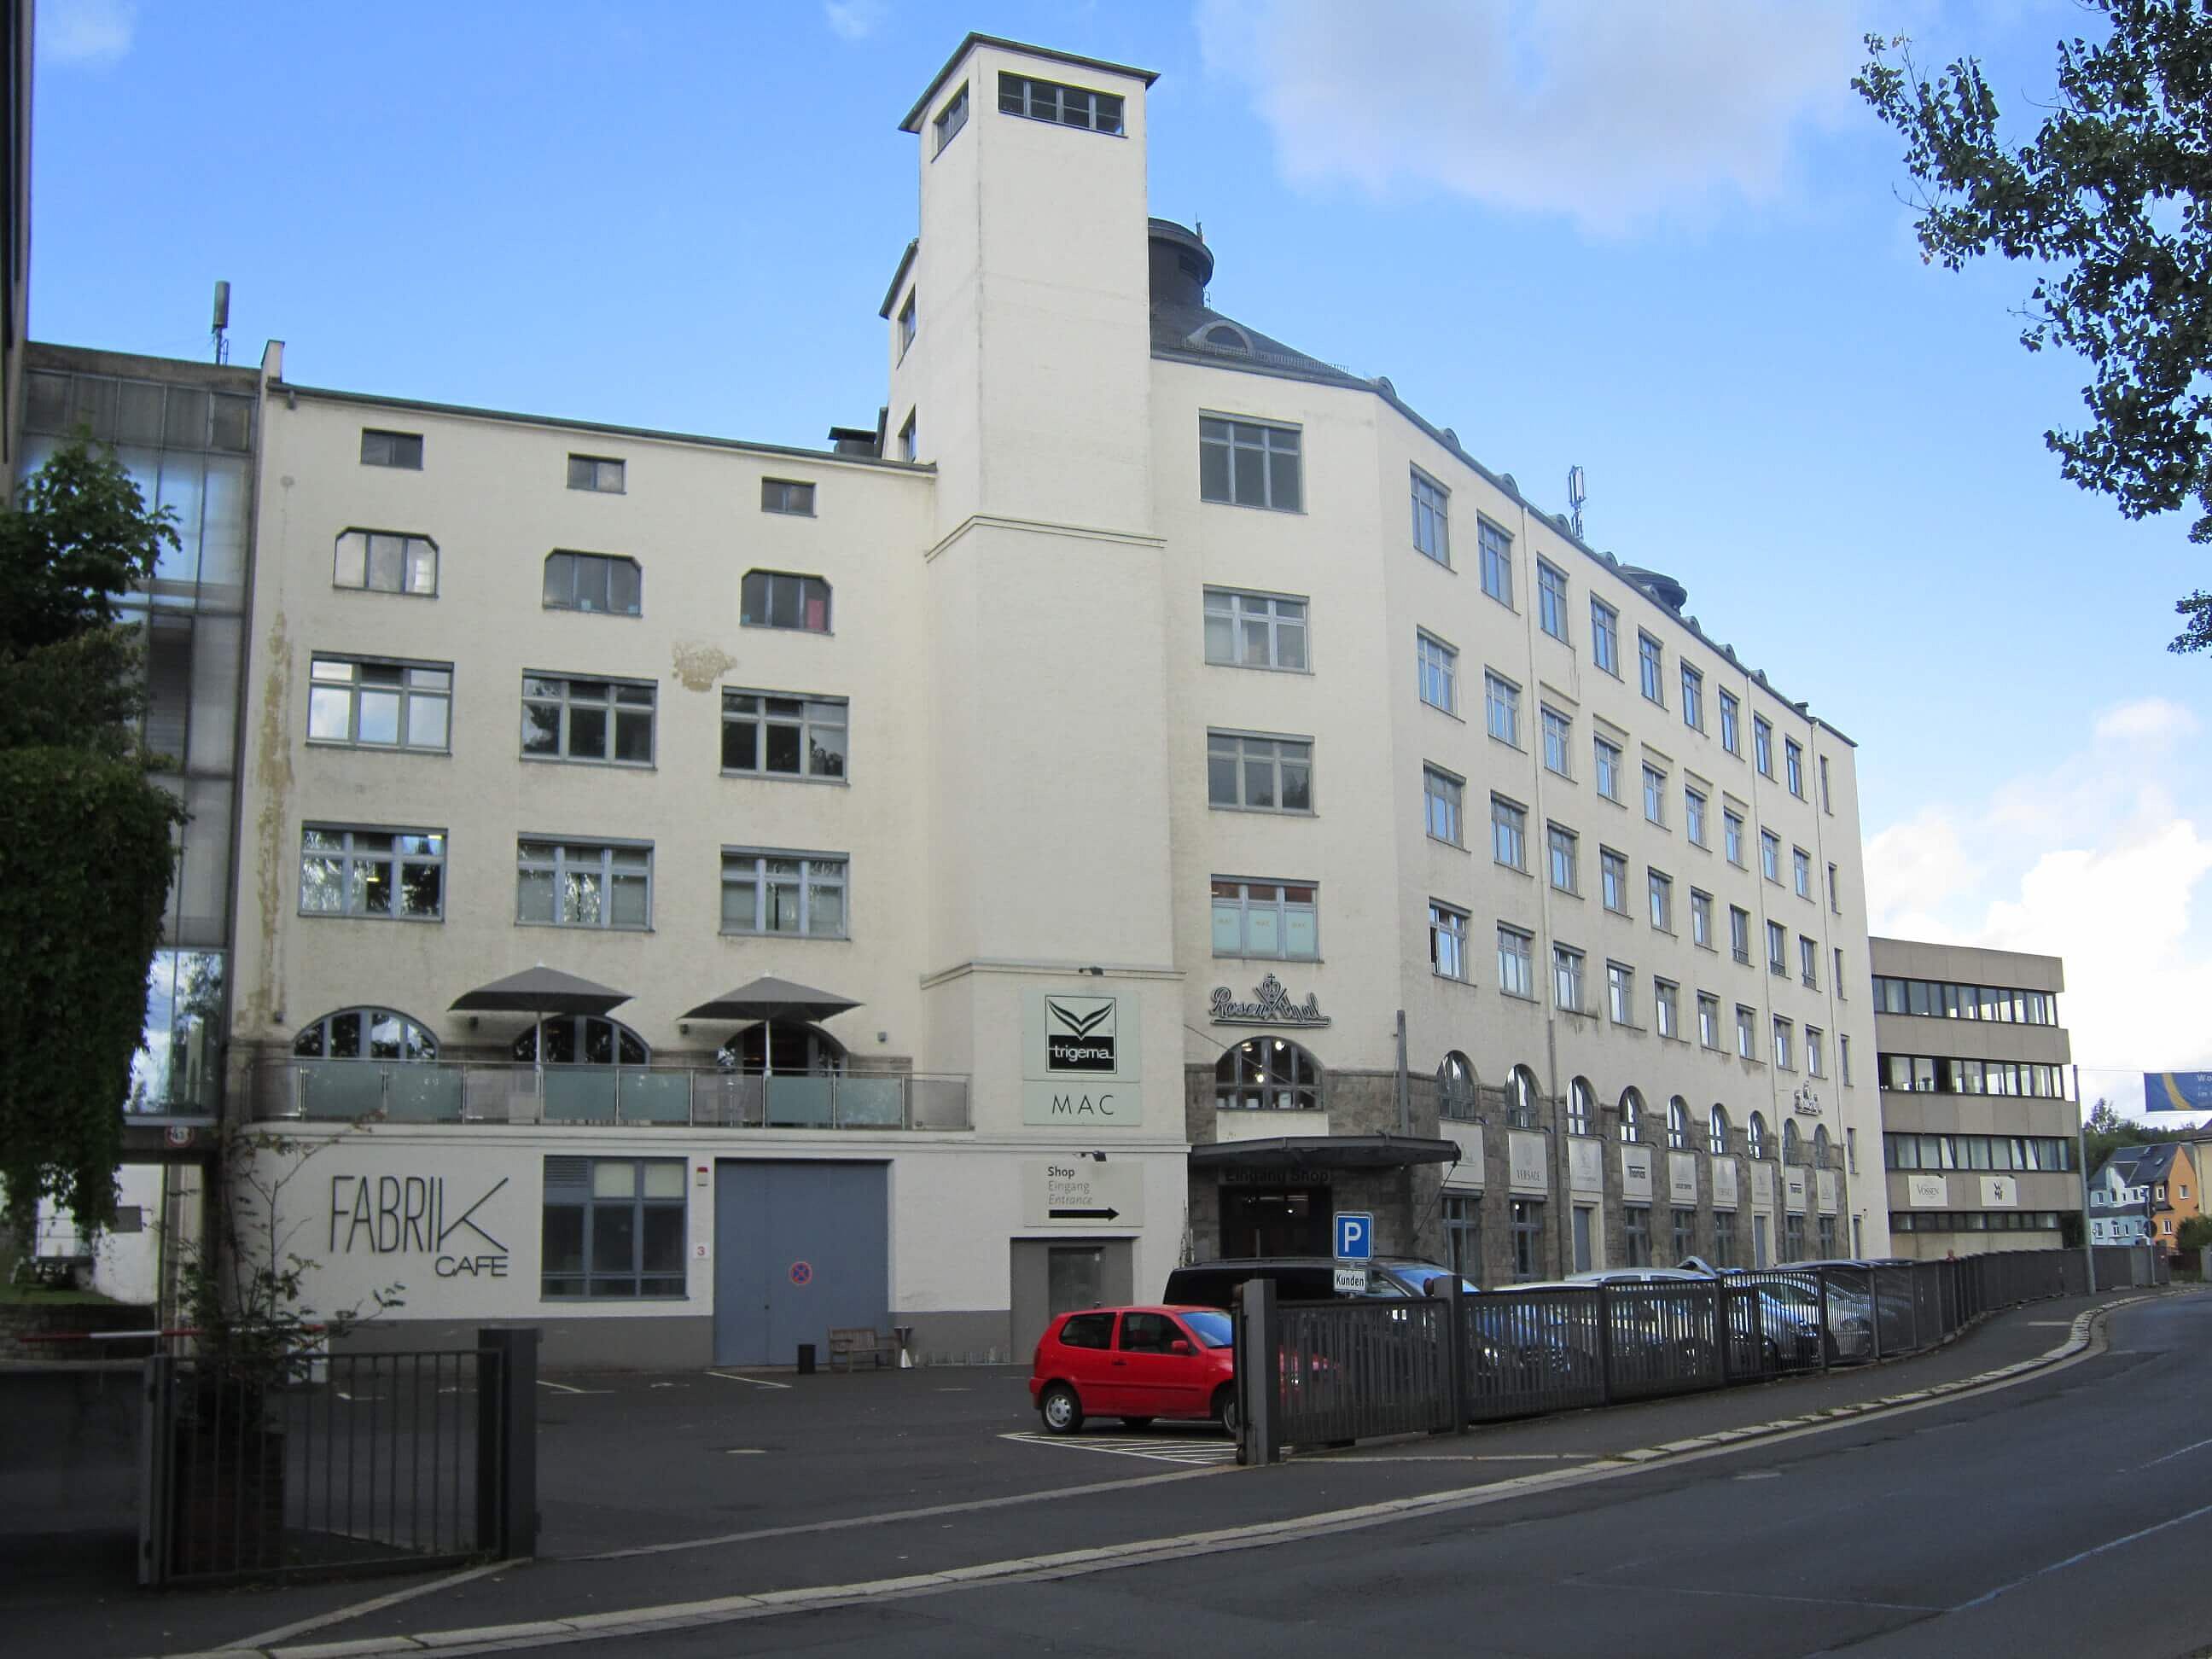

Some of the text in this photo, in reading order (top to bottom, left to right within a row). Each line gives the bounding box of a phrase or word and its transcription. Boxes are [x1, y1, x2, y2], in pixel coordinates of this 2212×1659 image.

[1210, 987, 1331, 1023] Rosenthal
[1051, 1045, 1113, 1062] trigema
[1052, 1094, 1114, 1115] MAC
[1048, 1166, 1075, 1179] Shop
[1049, 1180, 1091, 1195] Eingang
[1049, 1194, 1093, 1205] Entrance
[330, 1176, 509, 1253] FABRIK
[1344, 1221, 1362, 1253] P
[697, 1246, 705, 1256] 3
[435, 1255, 509, 1278] CAFE
[1336, 1274, 1365, 1287] Kunden
